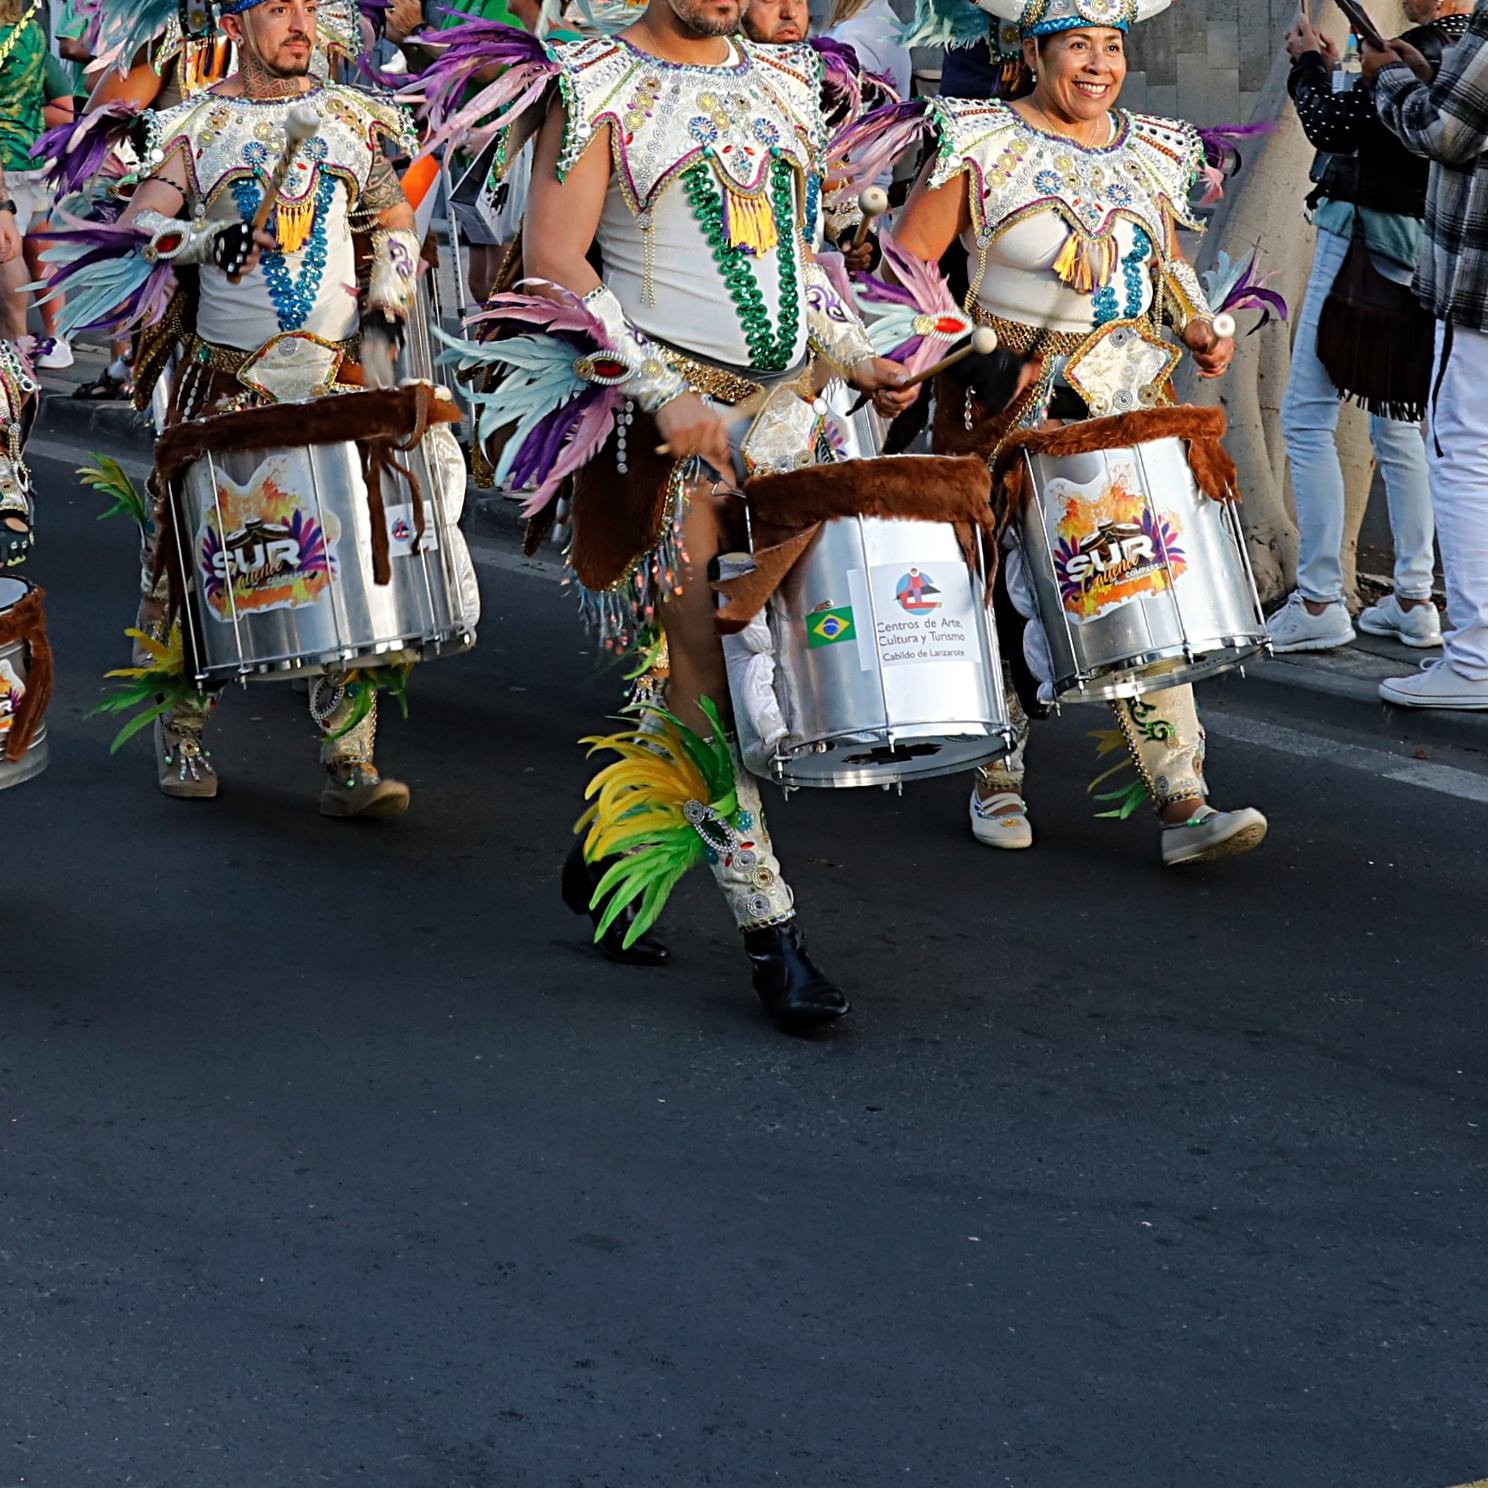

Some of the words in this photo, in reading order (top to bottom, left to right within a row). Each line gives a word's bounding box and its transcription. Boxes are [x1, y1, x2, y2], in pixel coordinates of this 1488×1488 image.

[212, 538, 302, 579] SUR
[1065, 534, 1156, 583] SUR
[877, 622, 920, 633] Centros
[924, 618, 937, 628] de
[878, 634, 918, 647] Cultura
[920, 635, 927, 645] y
[929, 631, 966, 641] Turismo
[882, 650, 916, 661] Cabildo
[917, 650, 928, 658] de
